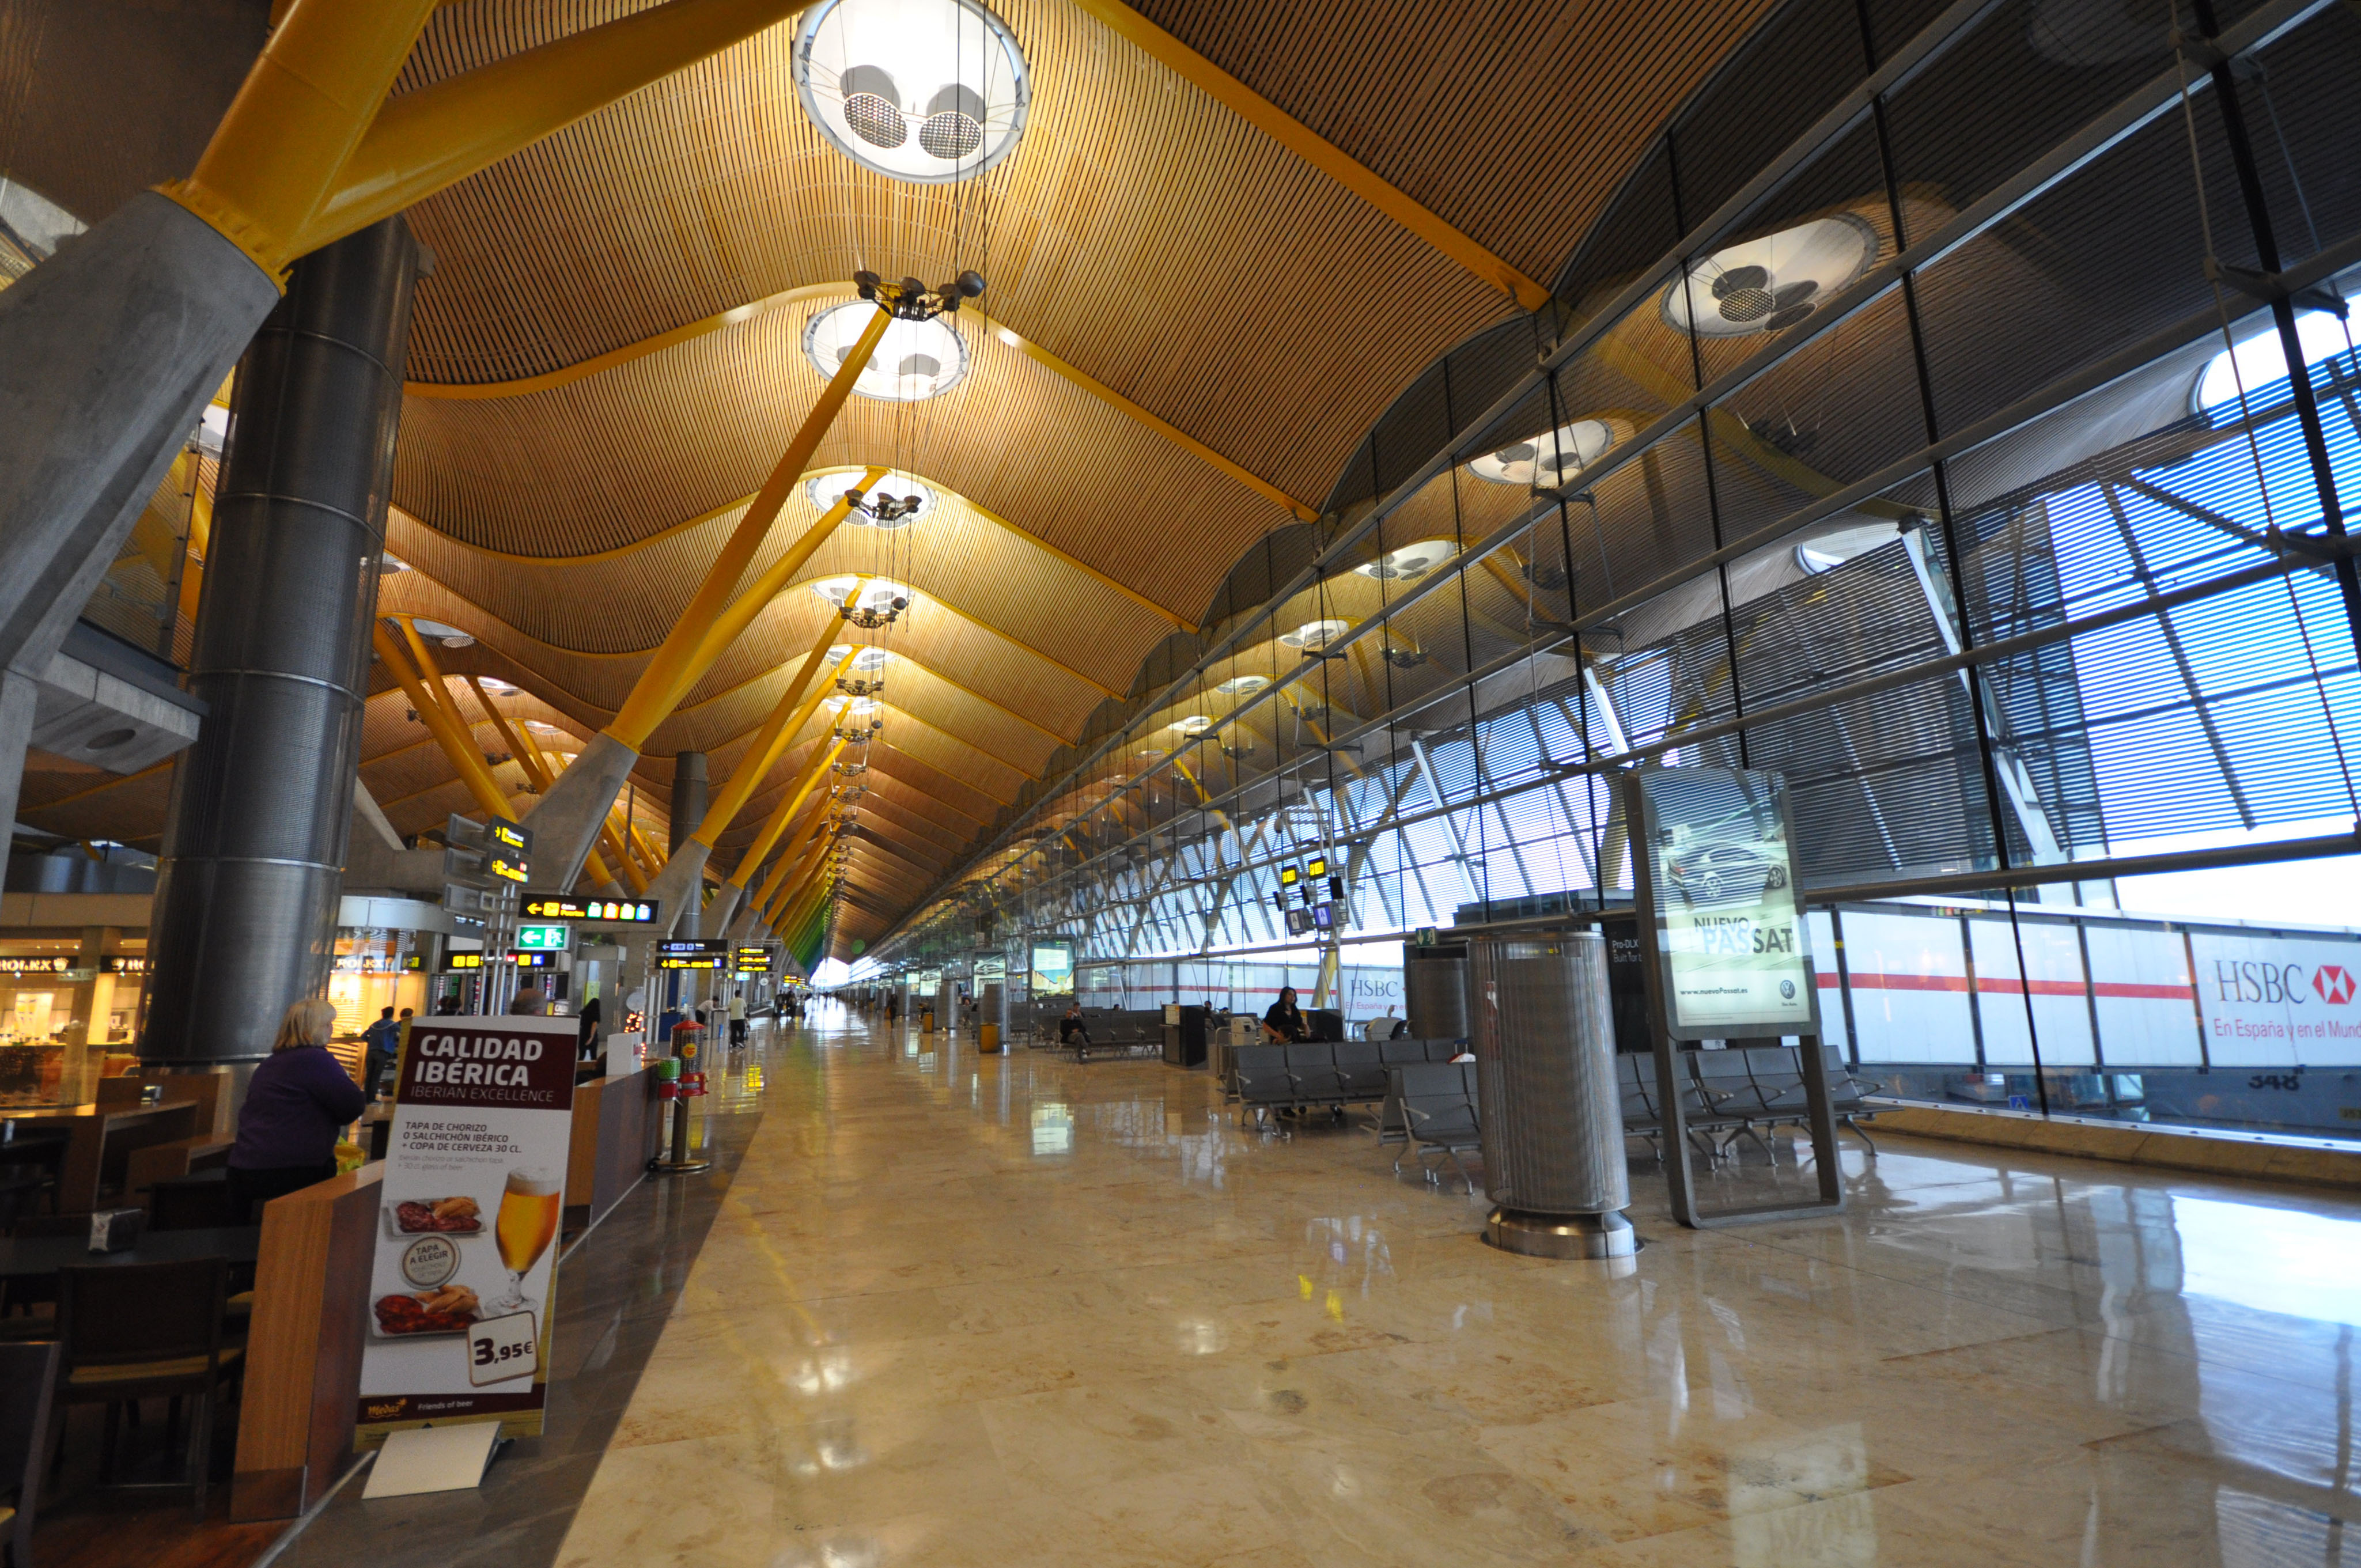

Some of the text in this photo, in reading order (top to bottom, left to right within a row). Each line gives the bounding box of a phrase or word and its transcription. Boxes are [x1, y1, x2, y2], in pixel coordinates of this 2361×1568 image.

[1694, 917, 1750, 932] NUEVO
[1703, 928, 1793, 954] PASSAT
[533, 956, 541, 964] K
[1350, 980, 1398, 997] HSBC
[2214, 960, 2307, 1004] HSBC
[1357, 1002, 1382, 1010] España
[2214, 1018, 2233, 1036] En
[2235, 1019, 2284, 1041] España
[2287, 1025, 2294, 1041] y
[2297, 1024, 2312, 1037] en
[2314, 1020, 2326, 1037] el
[419, 1035, 543, 1061] CALIDAD
[414, 1058, 529, 1086] IBÉRICA
[411, 1086, 554, 1102] IBERIAN EXCELLENCE
[406, 1122, 429, 1130] TAPA
[447, 1123, 487, 1132] CHORIZO
[472, 1133, 509, 1142] IBÉRICO
[410, 1142, 434, 1150] COPA
[437, 1143, 449, 1151] DE
[452, 1143, 493, 1152] CERVEZA
[495, 1145, 507, 1153] 30
[416, 1244, 439, 1255] TAPA
[410, 1251, 448, 1265] A ELEGIR
[474, 1338, 533, 1366] 3,95€
[418, 1402, 445, 1410] Friends
